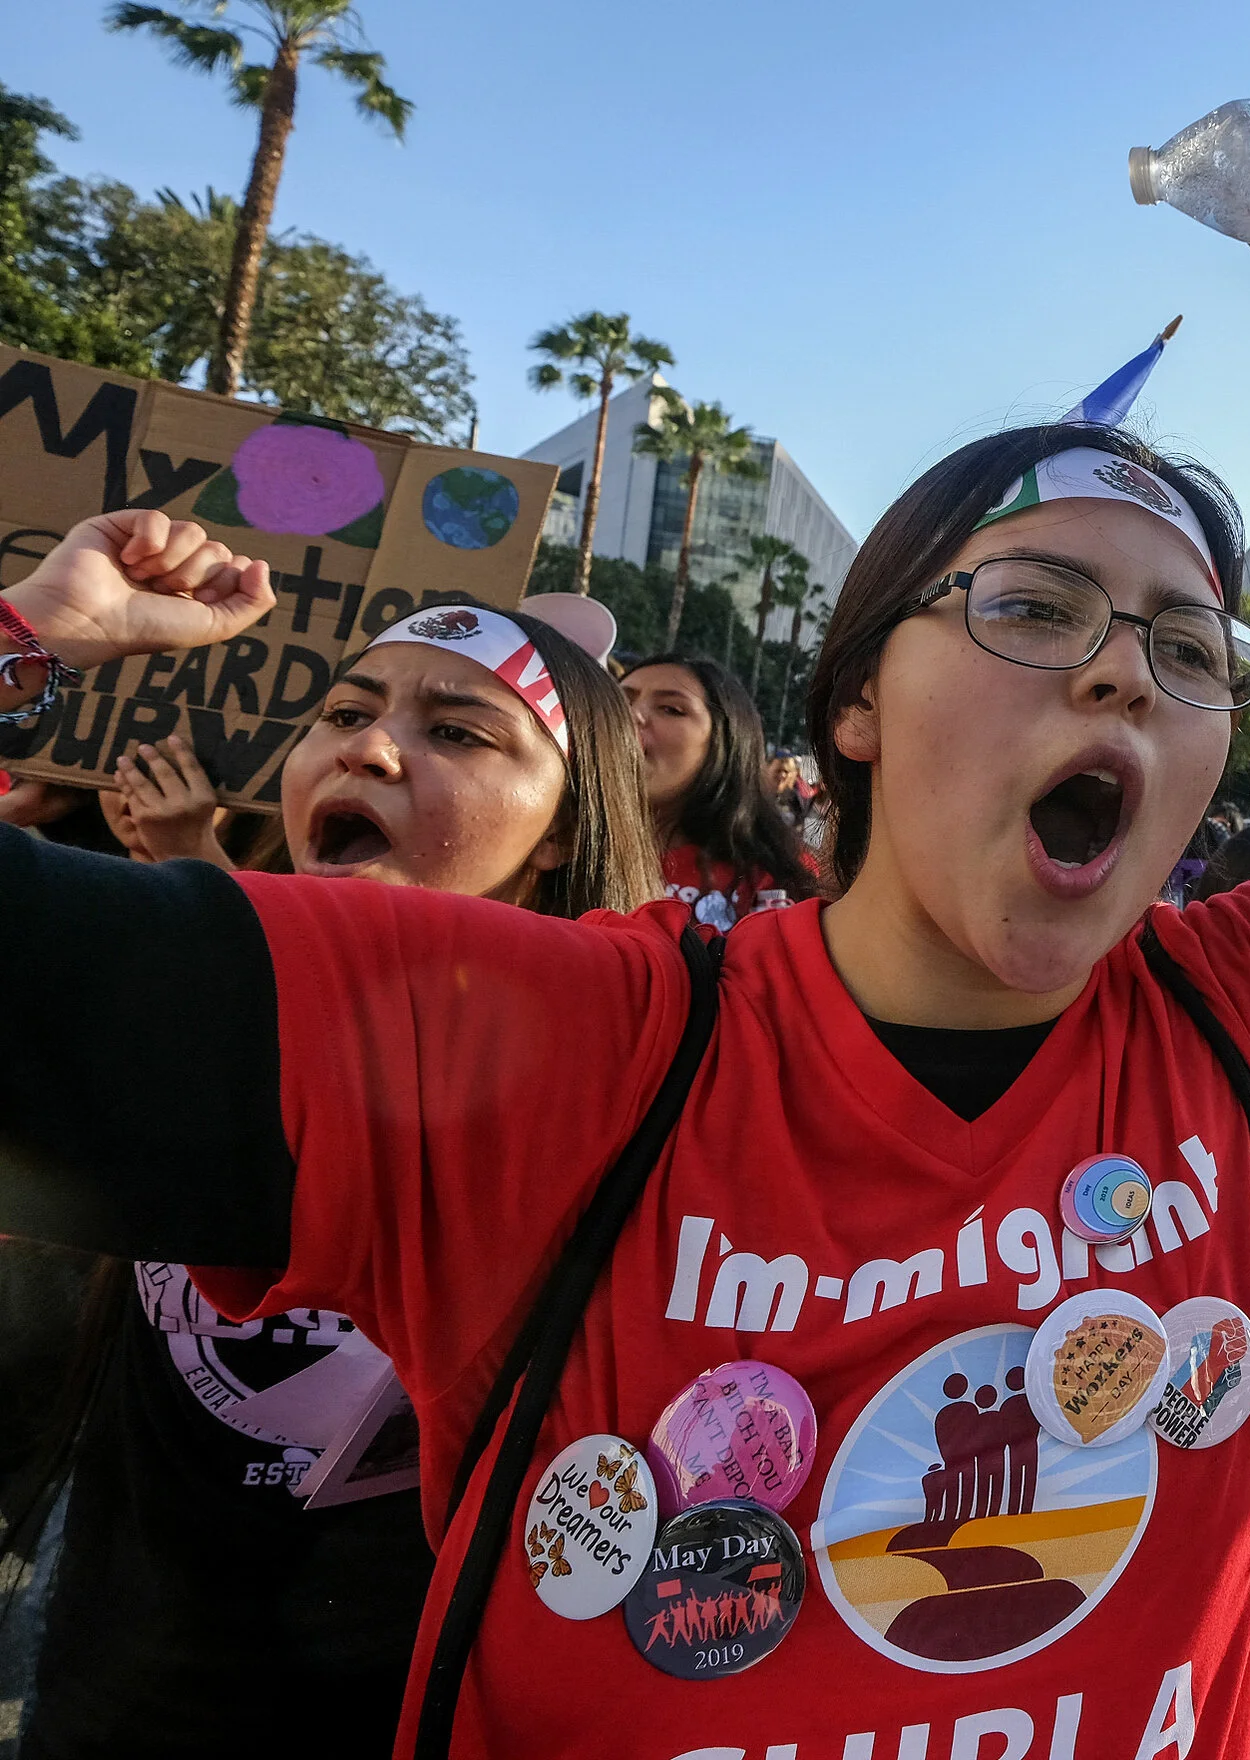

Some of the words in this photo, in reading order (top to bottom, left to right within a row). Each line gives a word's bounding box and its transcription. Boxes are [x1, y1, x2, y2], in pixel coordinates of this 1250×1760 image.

[0, 358, 222, 514] My
[1100, 1186, 1109, 1202] 2019
[1125, 1190, 1135, 1209] IDEAS
[1064, 1327, 1144, 1416] Workers
[1075, 1335, 1113, 1380] HAPPY
[1111, 1371, 1134, 1400] DAY
[1163, 1382, 1210, 1436] PEOPLE
[720, 1379, 760, 1445] BITCH
[752, 1443, 783, 1491] YOU
[750, 1369, 776, 1404] I'M
[765, 1410, 779, 1425] A
[774, 1424, 804, 1471] BAD
[686, 1452, 711, 1488] ME
[536, 1471, 632, 1576] Dreamers
[561, 1463, 589, 1500] We
[600, 1502, 632, 1535] our
[652, 1544, 712, 1574] May
[722, 1533, 776, 1561] Day
[694, 1641, 745, 1672] 2019
